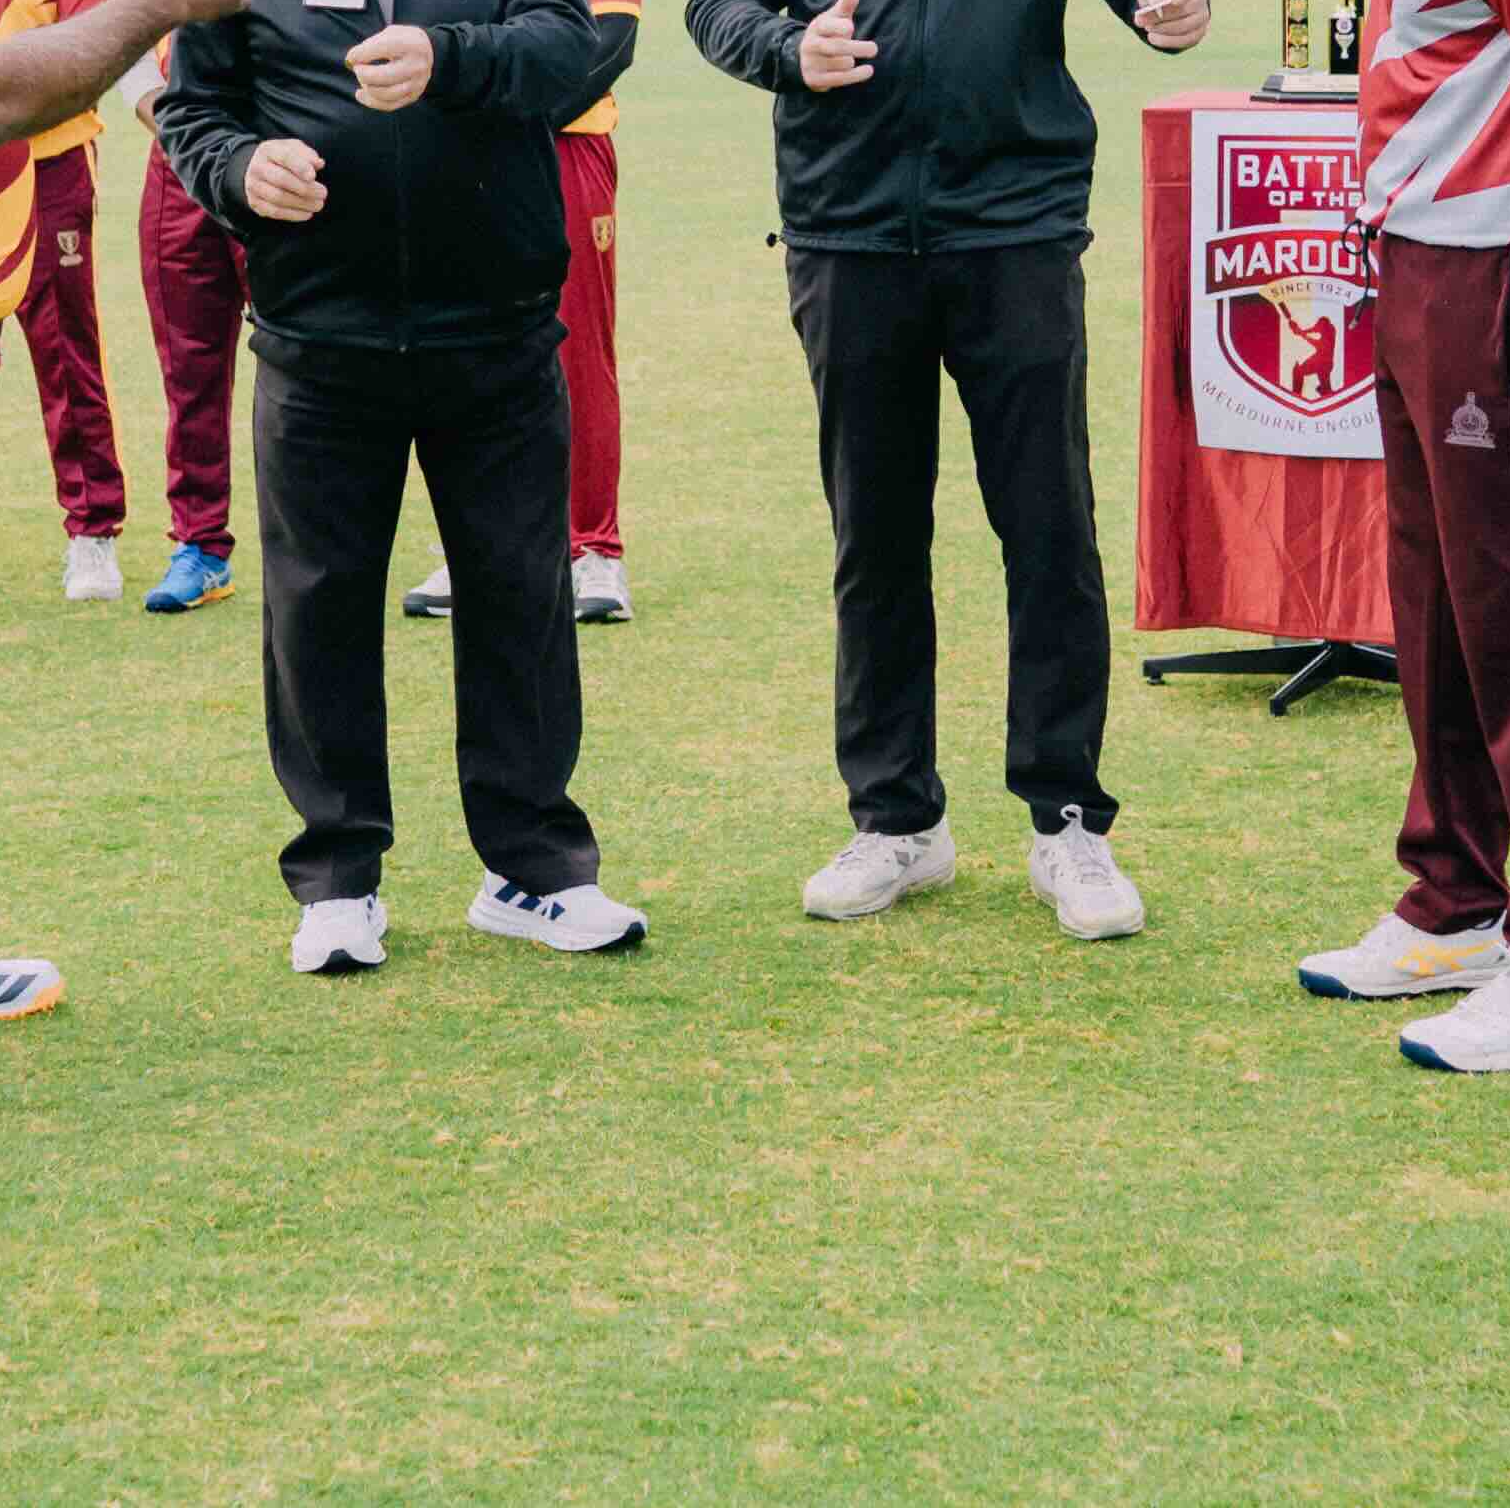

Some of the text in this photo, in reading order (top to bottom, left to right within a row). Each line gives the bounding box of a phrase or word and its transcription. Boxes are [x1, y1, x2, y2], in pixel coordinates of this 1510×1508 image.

[1237, 154, 1360, 189] BATTL
[1268, 190, 1304, 207] OF
[1213, 239, 1379, 283] MAROON
[1270, 282, 1352, 299] SINCE 1924
[1201, 380, 1375, 434] MELBOURNE ENCOU
